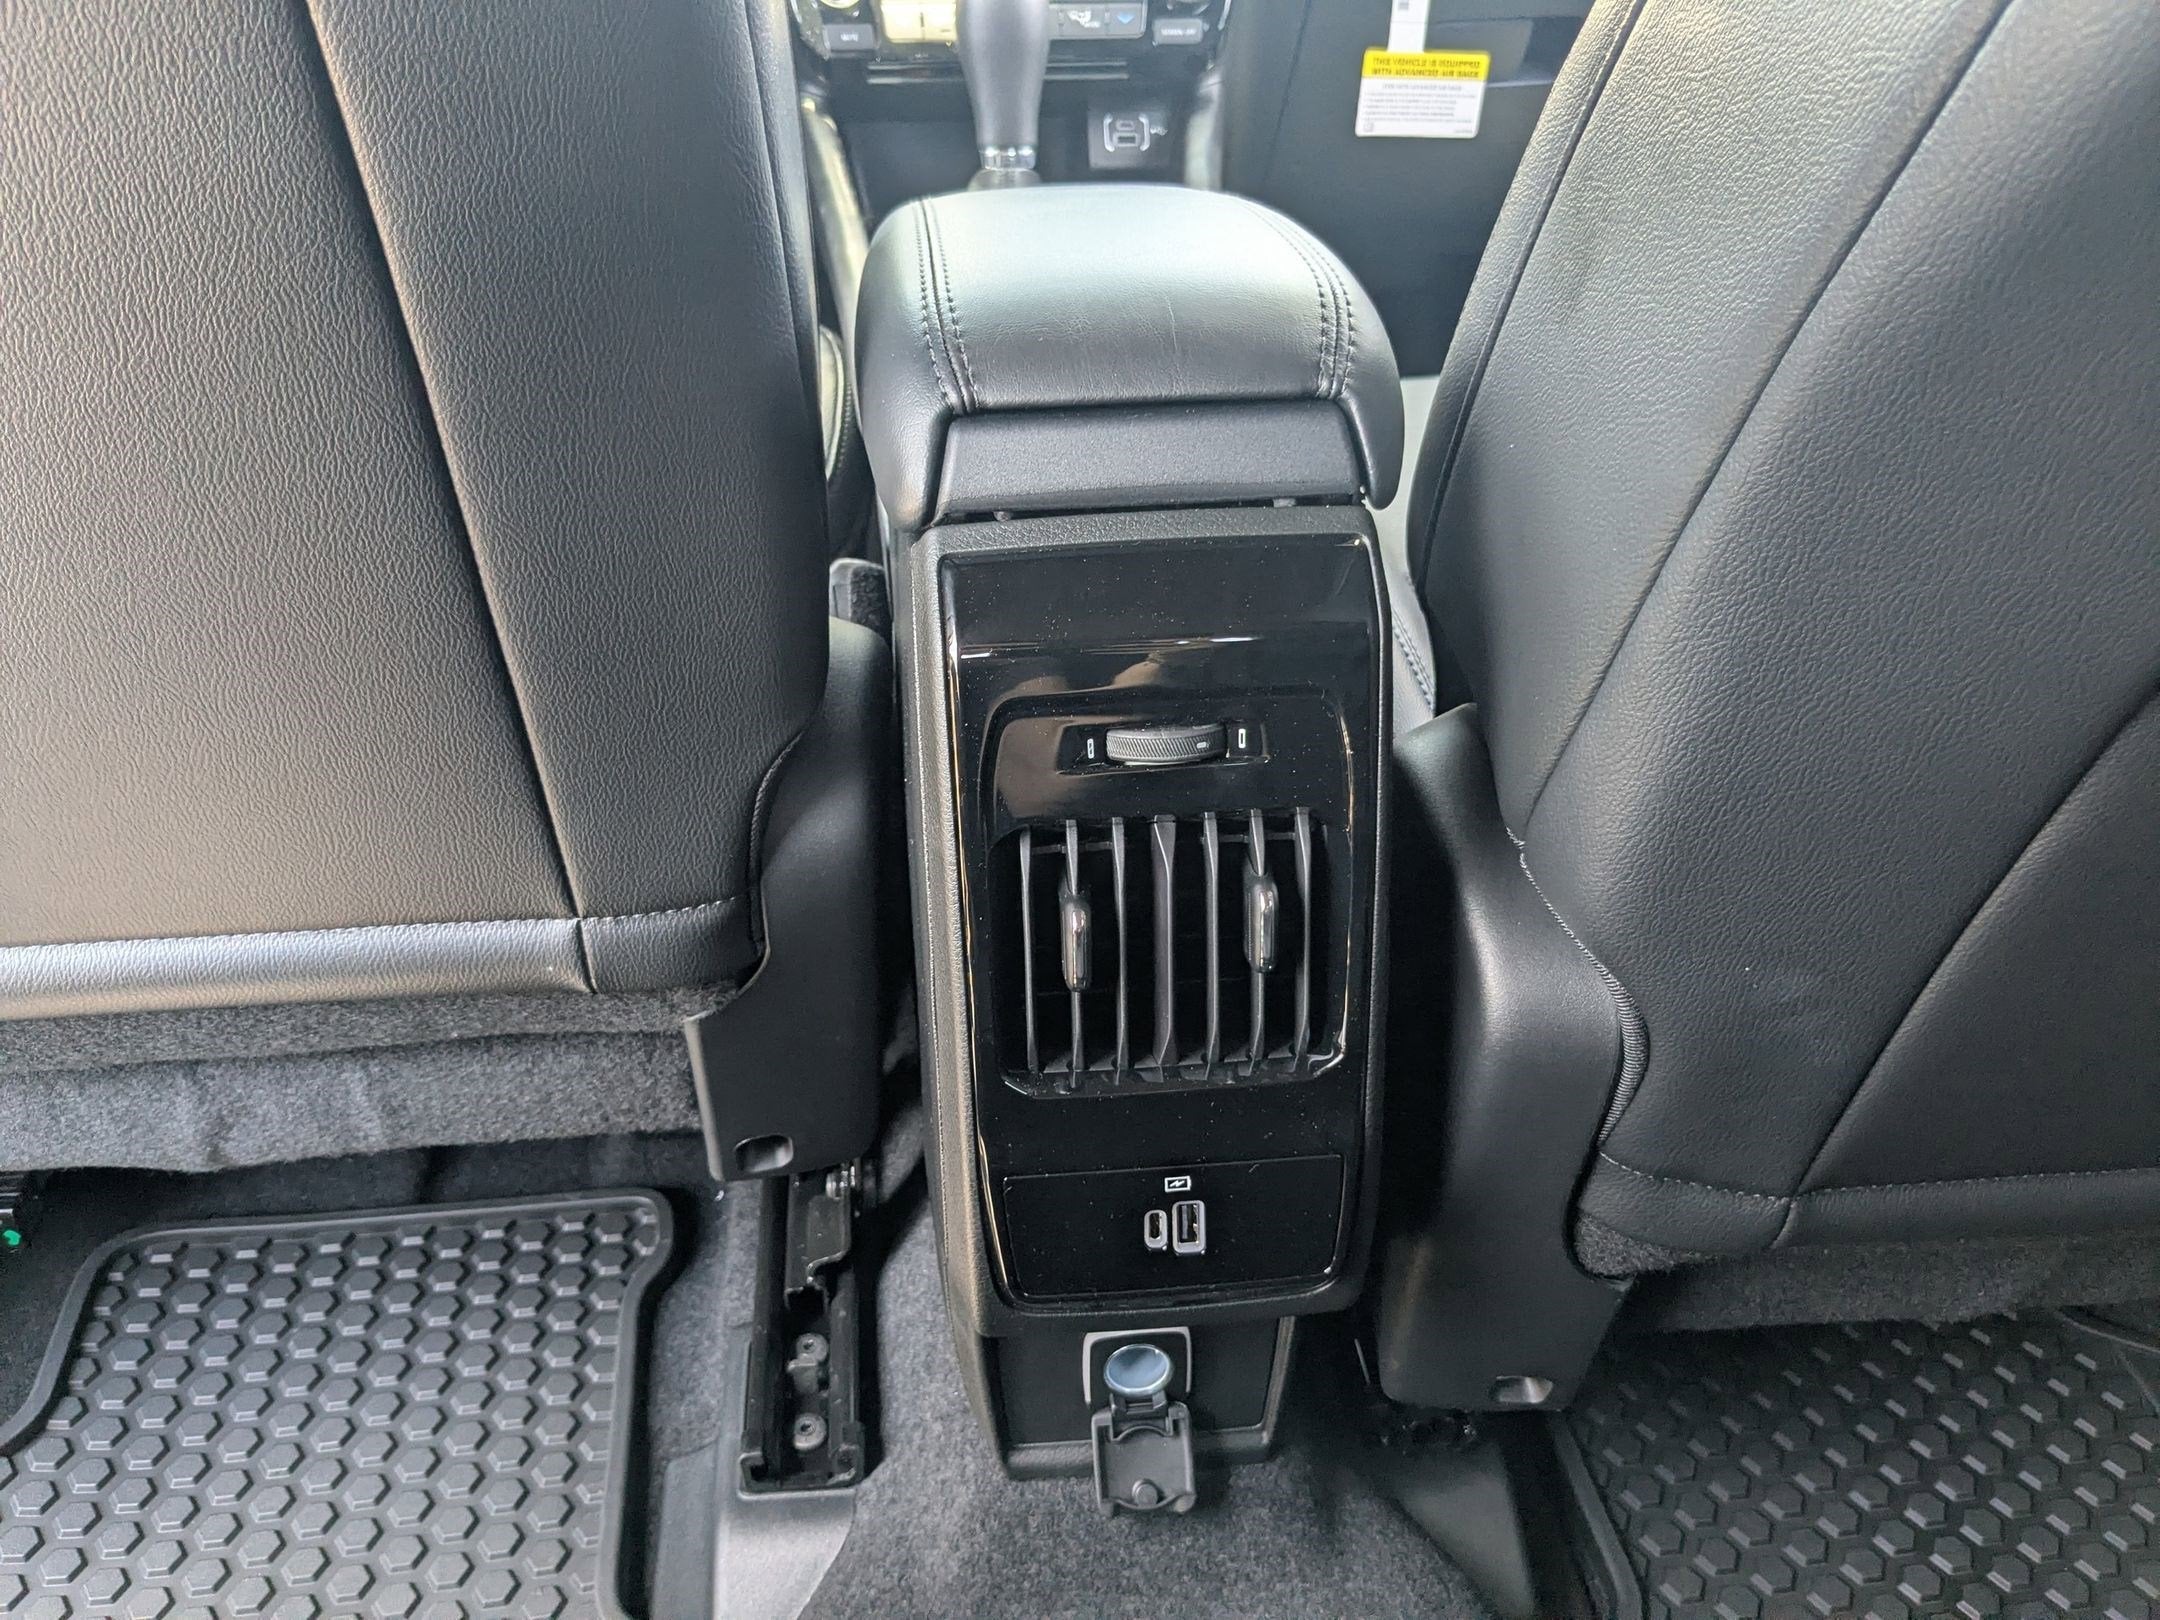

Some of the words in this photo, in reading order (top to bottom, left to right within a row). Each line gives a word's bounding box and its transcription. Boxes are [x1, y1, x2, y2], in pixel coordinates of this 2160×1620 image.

[1392, 58, 1427, 67] VEHICLE
[1438, 59, 1480, 69] EQUIPPED
[1373, 67, 1392, 75] WITH
[1396, 68, 1439, 77] ADVANCED
